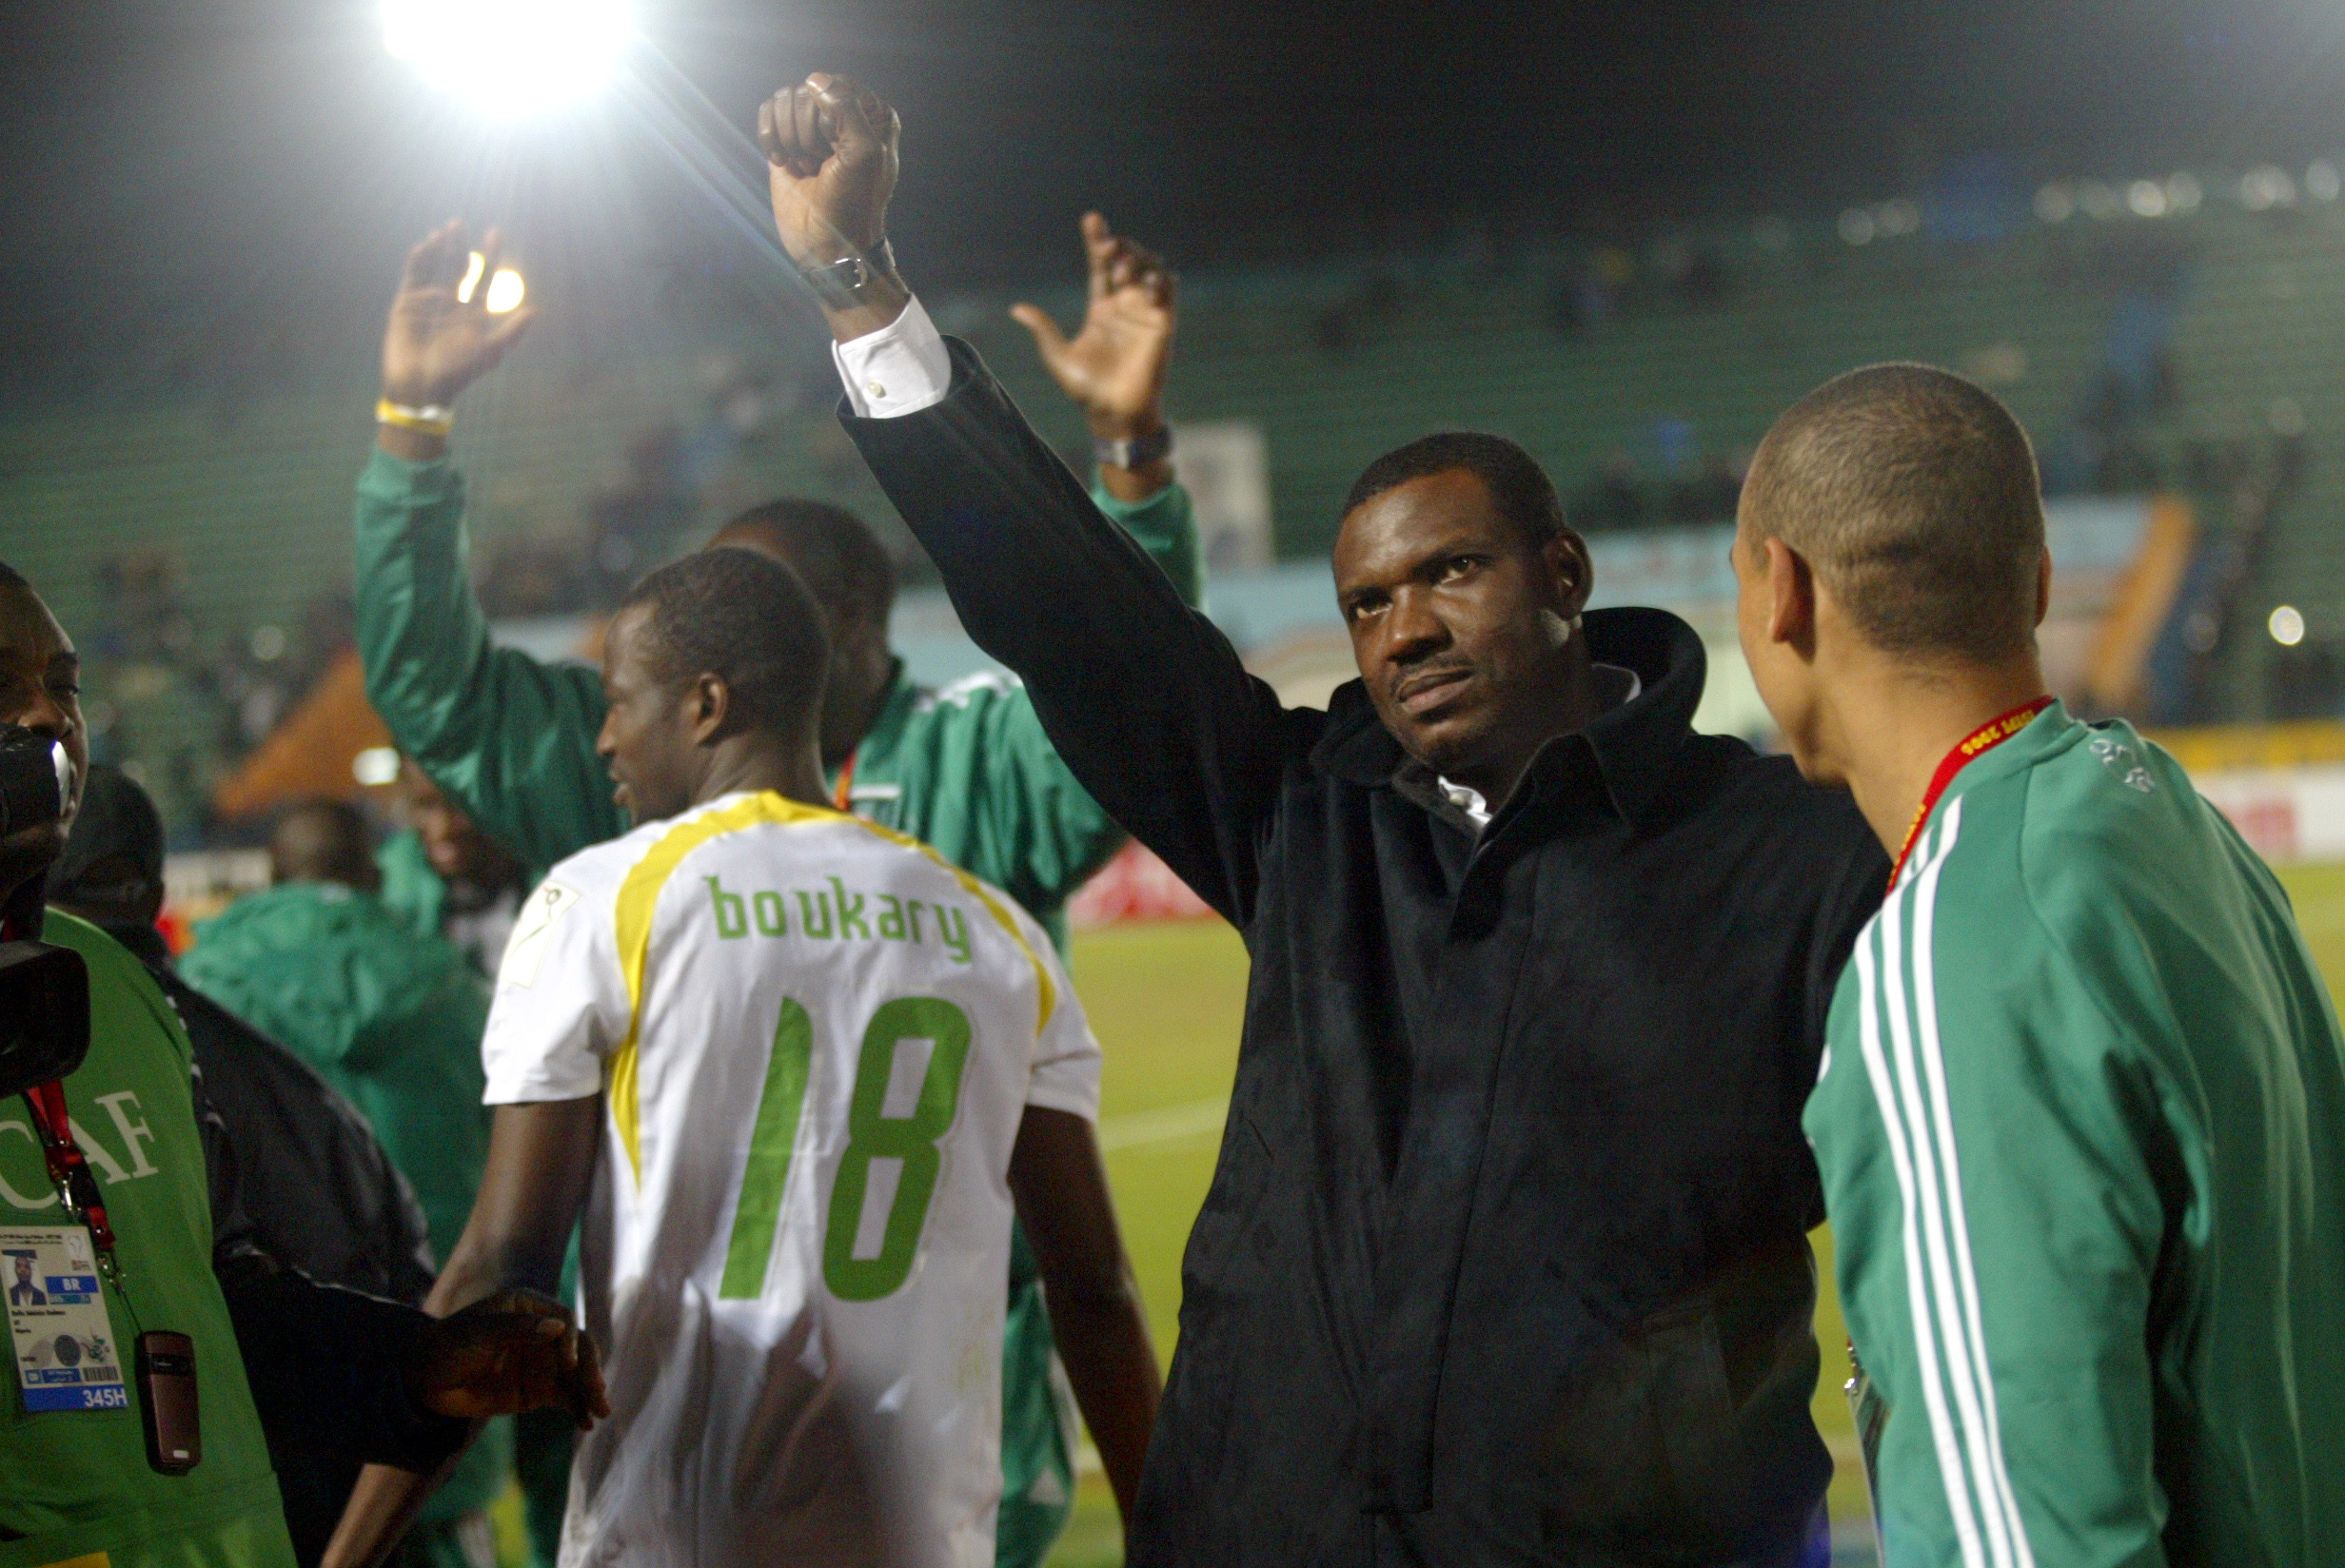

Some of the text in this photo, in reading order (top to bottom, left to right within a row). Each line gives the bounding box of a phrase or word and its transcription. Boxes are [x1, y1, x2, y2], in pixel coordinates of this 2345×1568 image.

[703, 875, 971, 965] boukary
[0, 1090, 159, 1210] CAF
[719, 995, 971, 1303] 18
[83, 1387, 128, 1408] 345H
